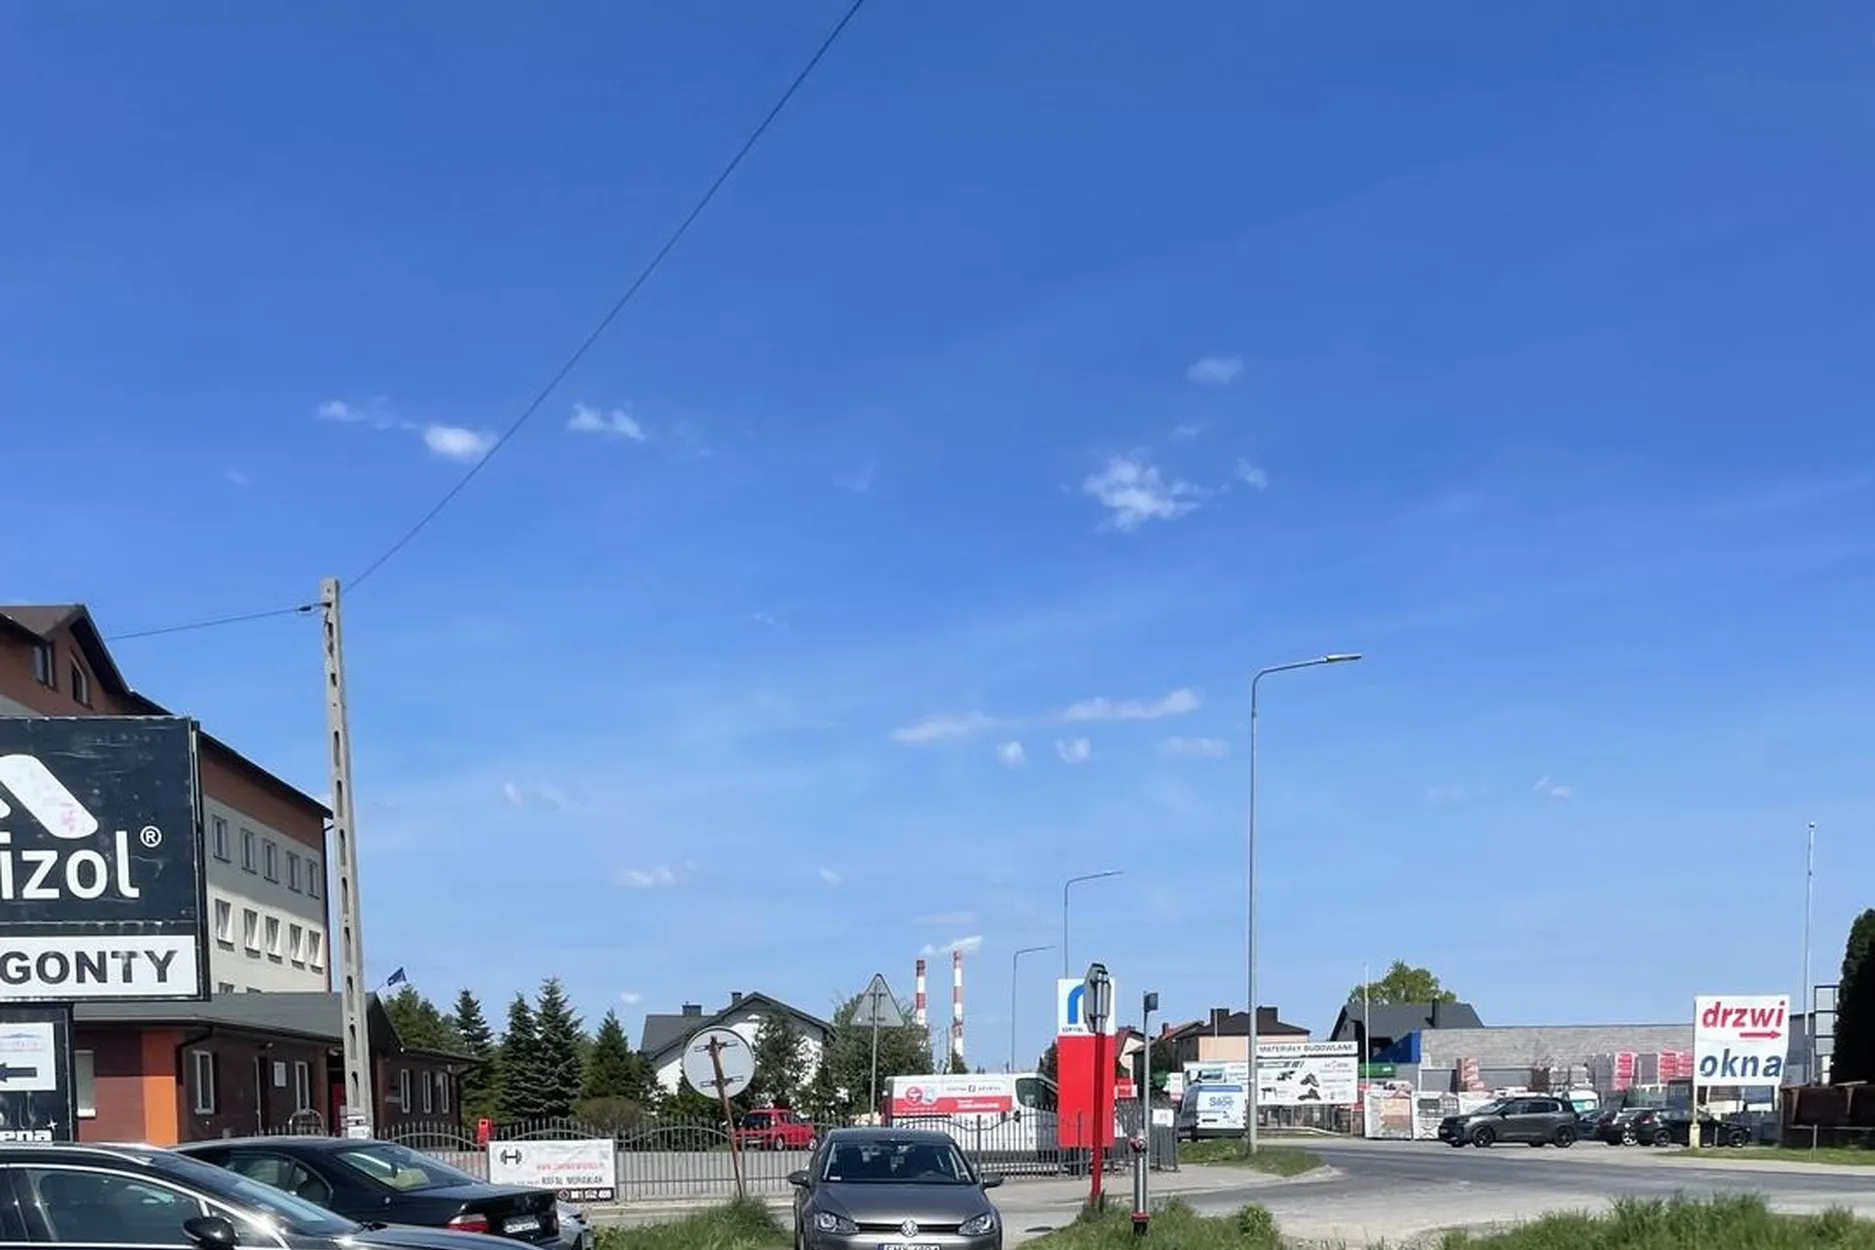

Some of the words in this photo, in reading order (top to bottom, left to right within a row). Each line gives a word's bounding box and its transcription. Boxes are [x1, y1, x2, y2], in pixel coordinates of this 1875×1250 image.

[0, 950, 178, 985] GONTY
[1702, 1000, 1785, 1028] drzwi
[1303, 1043, 1354, 1052] BUDOWLANE
[1699, 1048, 1782, 1077] okna
